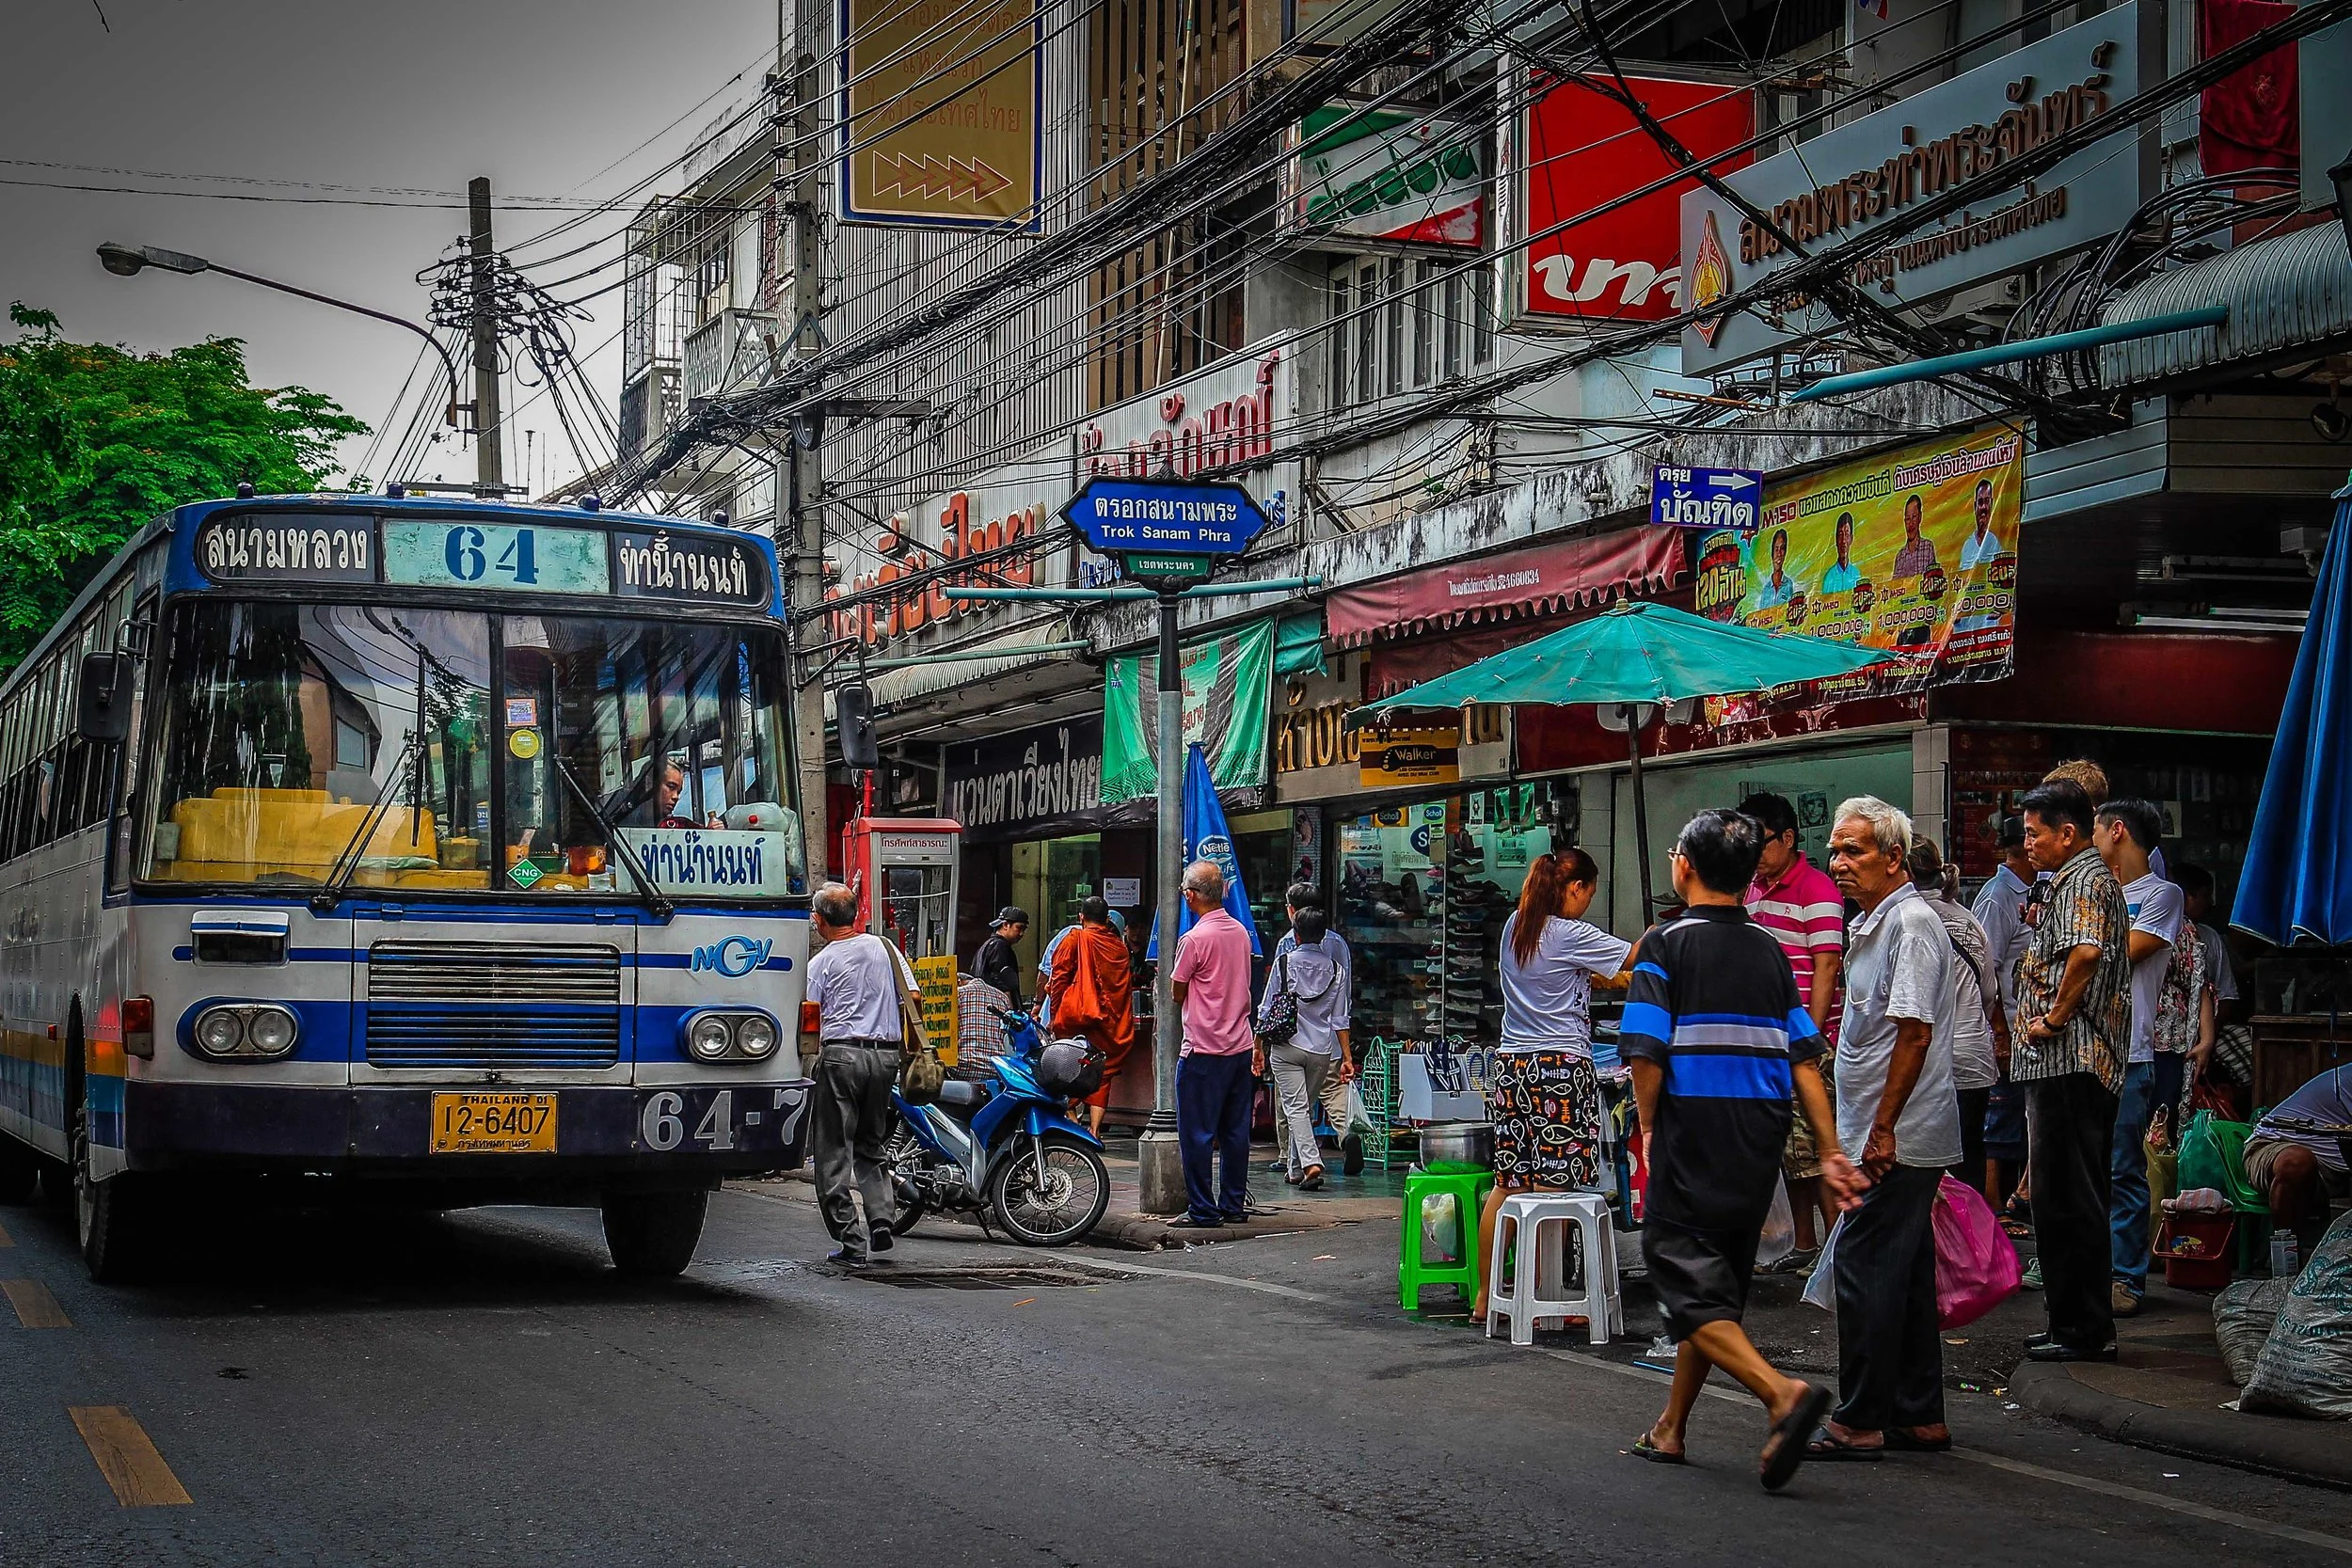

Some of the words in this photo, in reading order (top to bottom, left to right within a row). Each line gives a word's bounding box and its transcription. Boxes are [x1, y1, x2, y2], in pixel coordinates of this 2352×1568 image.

[1659, 467, 1692, 488] ครุย
[1095, 497, 1237, 522] ตรอกสนามพระ
[1661, 489, 1754, 527] บัณฑิต
[205, 522, 369, 570] สนามหลวง
[1101, 525, 1135, 538] Trok
[1142, 526, 1190, 540] Sanam
[1199, 528, 1231, 542] Phra
[444, 525, 540, 585] 64
[1139, 559, 1195, 571] เขตพระนคร
[1395, 748, 1437, 761] Walker
[953, 726, 1102, 827] แว่นตาเวียงไทย
[1425, 807, 1443, 816] Scholl
[882, 836, 947, 847] โทรศัพท์สาธารณะ
[641, 830, 766, 885] ท่าน้ำนนท์
[514, 867, 538, 878] CNG
[691, 934, 774, 979] NGV
[463, 1095, 530, 1105] THAILAND
[445, 1105, 550, 1135] 12-6407
[643, 1087, 809, 1151] 64-7
